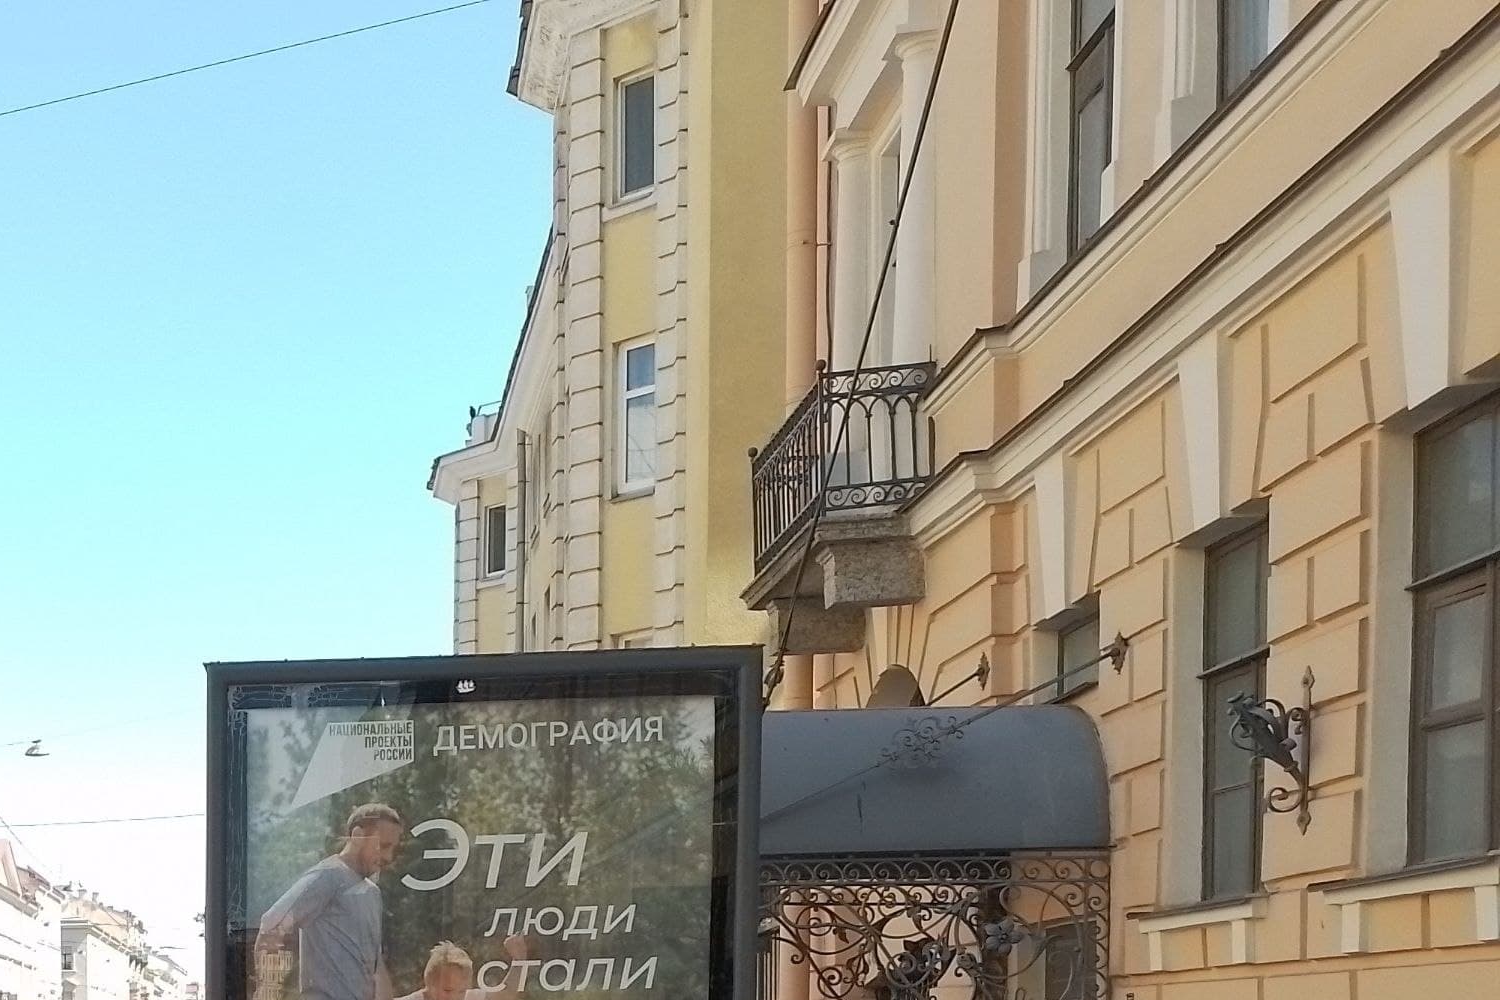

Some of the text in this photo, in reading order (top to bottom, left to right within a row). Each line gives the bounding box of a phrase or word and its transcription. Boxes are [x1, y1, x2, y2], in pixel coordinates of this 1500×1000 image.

[329, 722, 412, 736] НАЦИОНАЛЬНЫЕ
[365, 735, 412, 748] ПРОЕКТЫ
[433, 715, 664, 756] ДЕМОГРАФИЯ
[374, 748, 412, 760] РОССИИ
[401, 818, 589, 891] Эти
[484, 903, 637, 941] люди
[476, 956, 658, 992] стали
